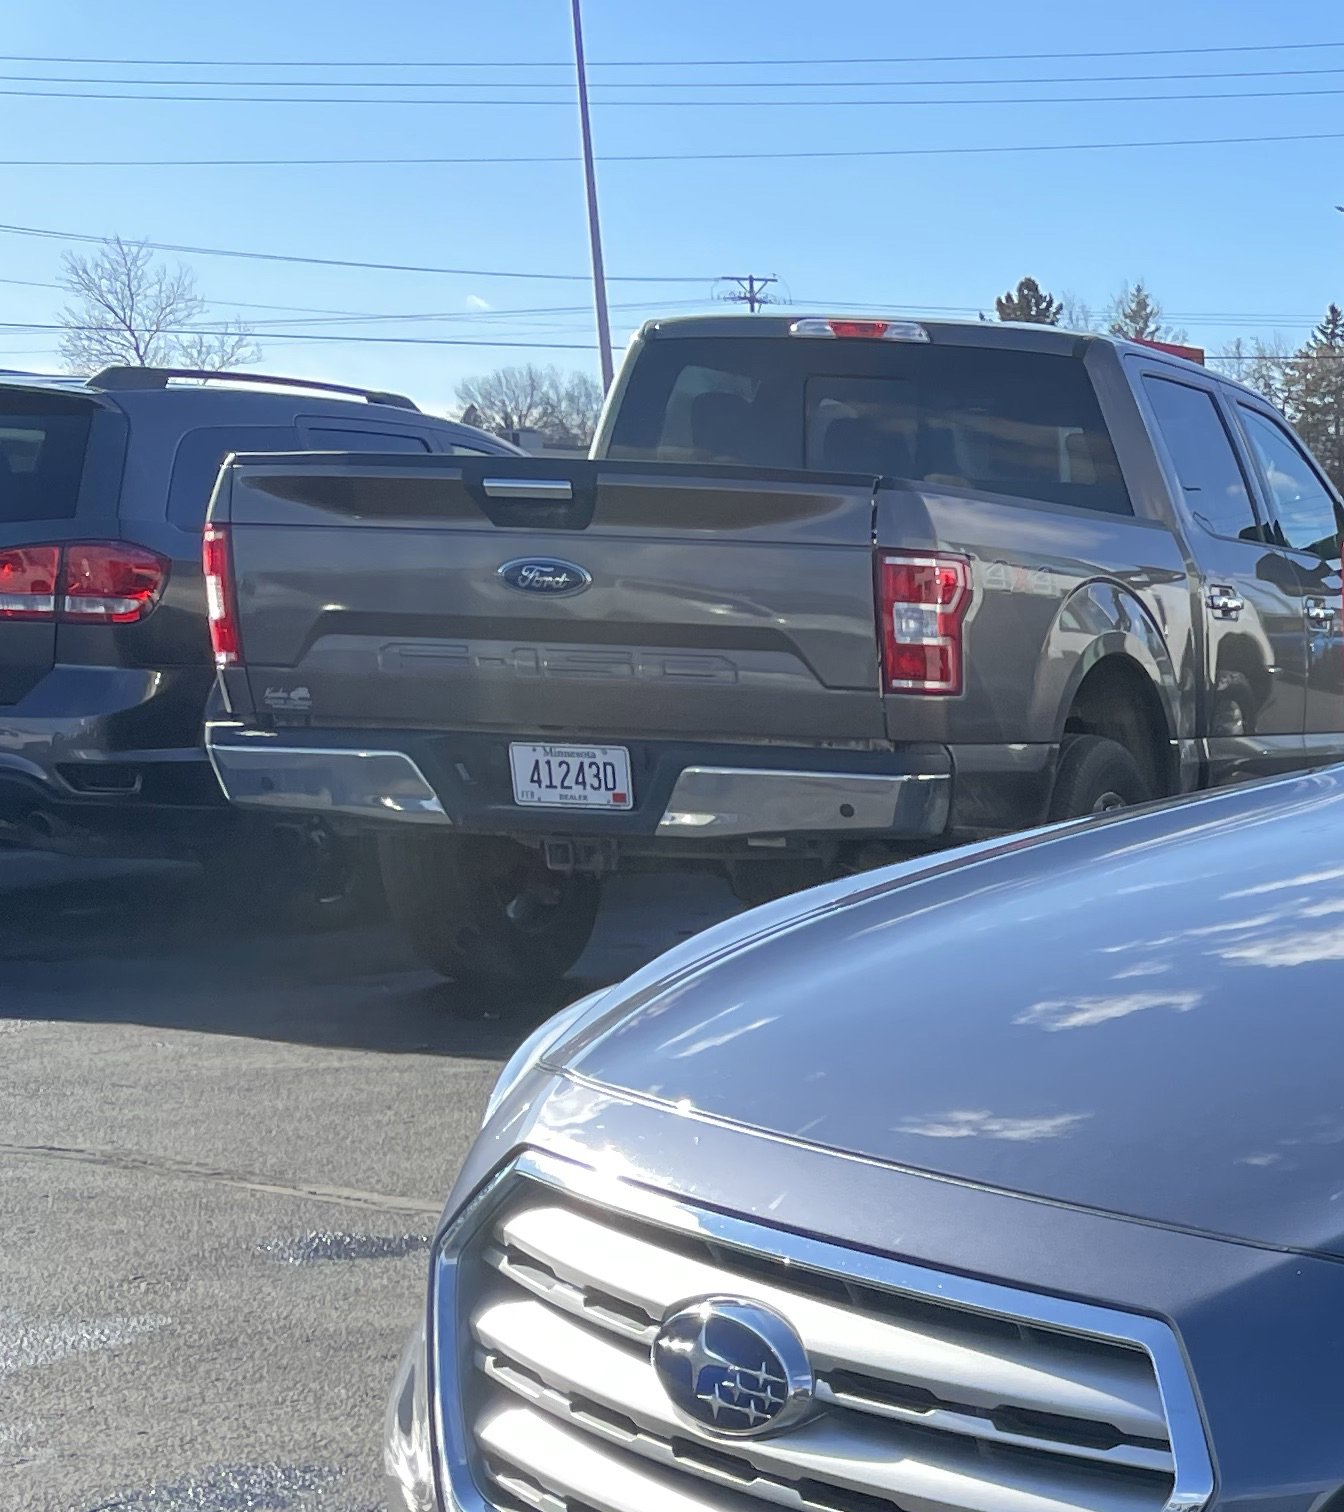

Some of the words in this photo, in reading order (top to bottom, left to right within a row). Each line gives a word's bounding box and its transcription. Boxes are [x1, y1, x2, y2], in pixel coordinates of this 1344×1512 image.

[518, 565, 571, 589] Ford
[543, 746, 597, 759] Minnesota
[530, 759, 616, 791] 41243D
[559, 793, 588, 801] DEALER
